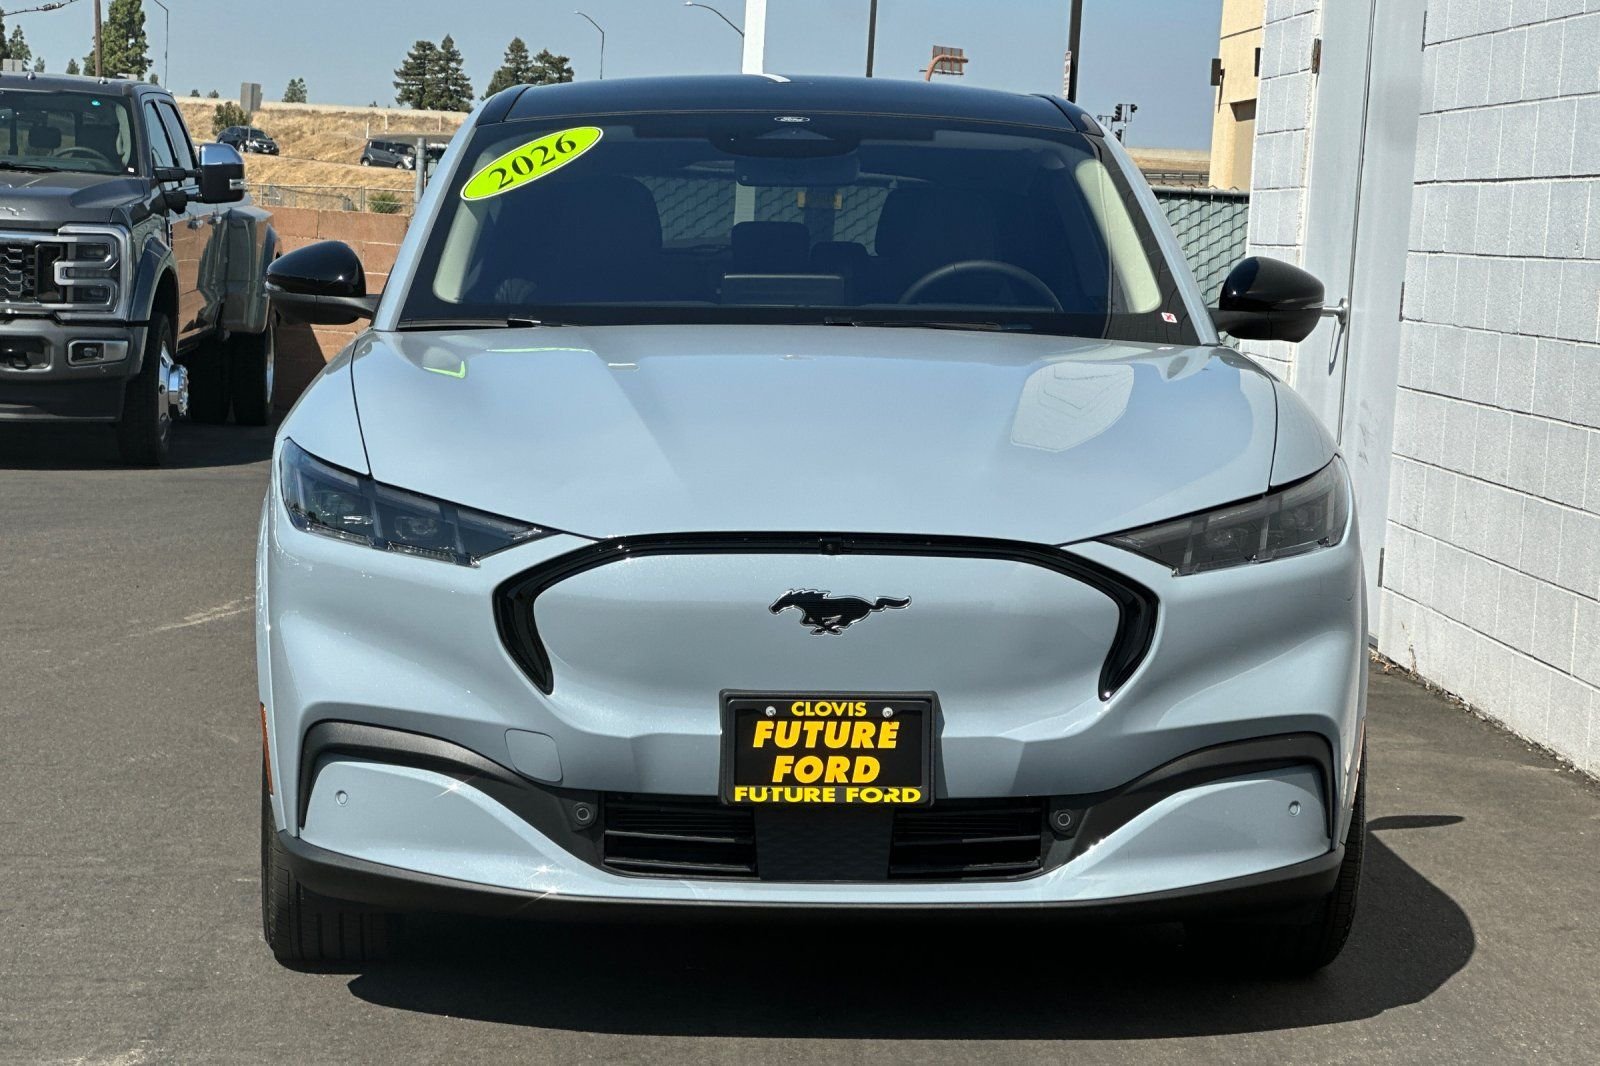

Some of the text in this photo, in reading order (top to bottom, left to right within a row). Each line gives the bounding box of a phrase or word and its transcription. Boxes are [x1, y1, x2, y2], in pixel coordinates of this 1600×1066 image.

[488, 134, 577, 190] 2026
[791, 701, 867, 717] CLOVIS
[753, 720, 900, 749] FUTURE
[772, 755, 881, 784] FORD
[734, 786, 921, 803] FUTURE FORD
